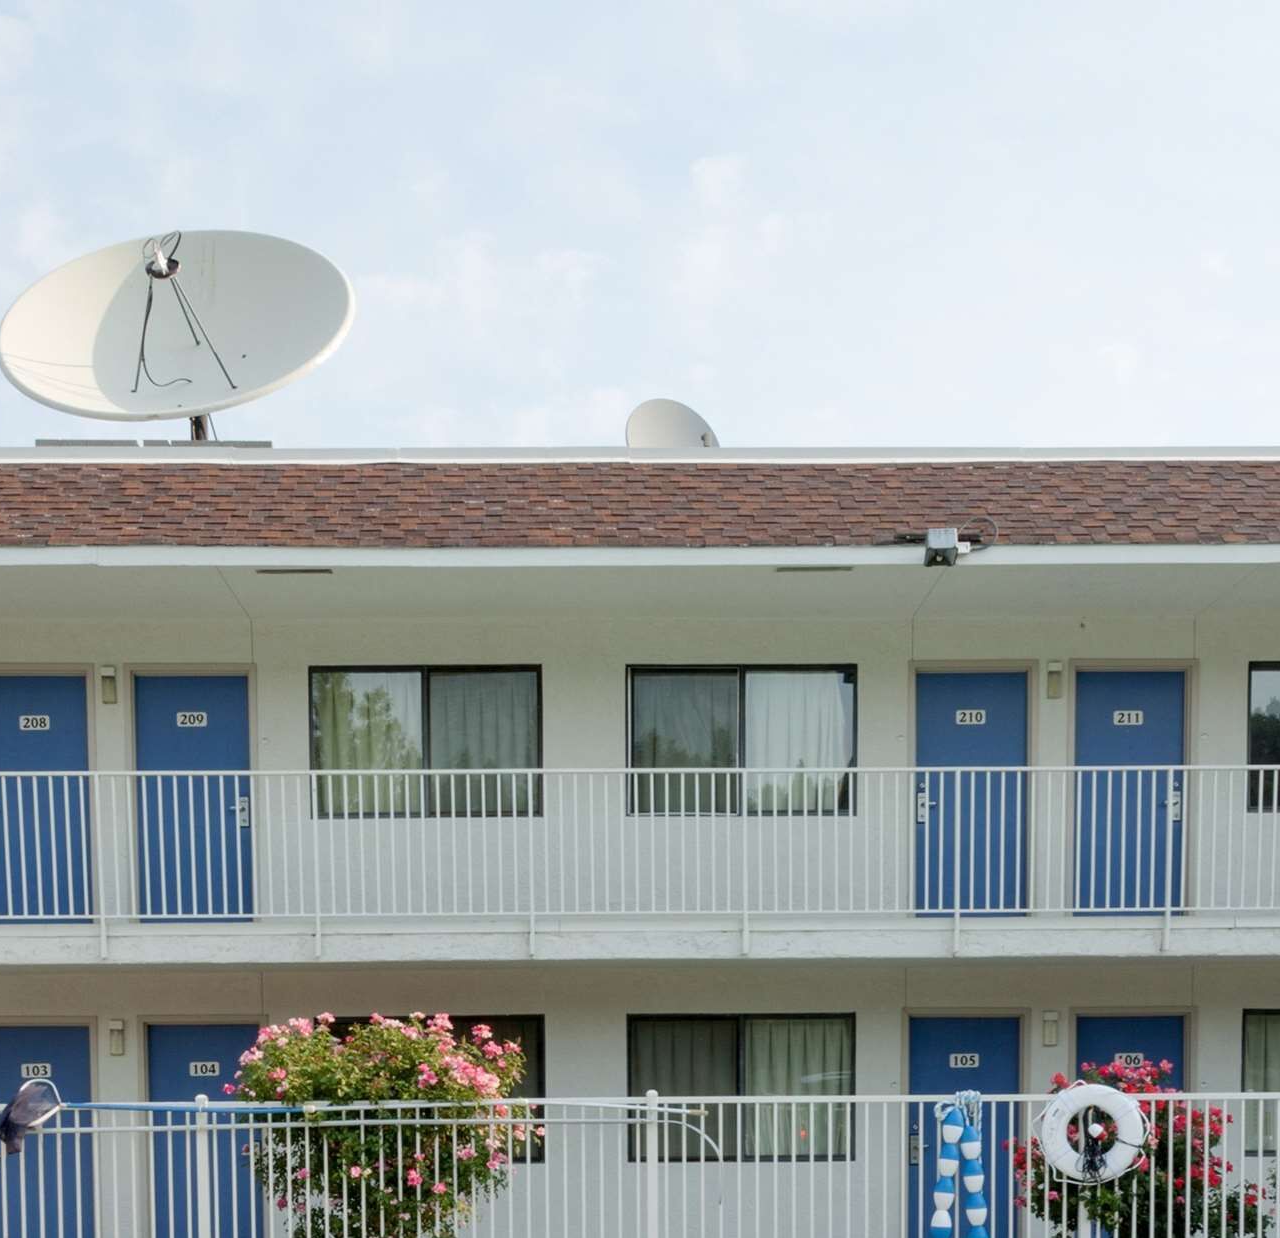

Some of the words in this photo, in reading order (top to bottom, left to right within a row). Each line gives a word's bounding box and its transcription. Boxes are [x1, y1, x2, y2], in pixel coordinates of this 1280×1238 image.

[23, 717, 47, 729] 208
[180, 714, 204, 725] 209
[959, 711, 983, 723] 210
[1118, 713, 1140, 724] 211
[953, 1055, 976, 1067] 105
[24, 1065, 48, 1077] 103
[193, 1063, 216, 1075] 104
